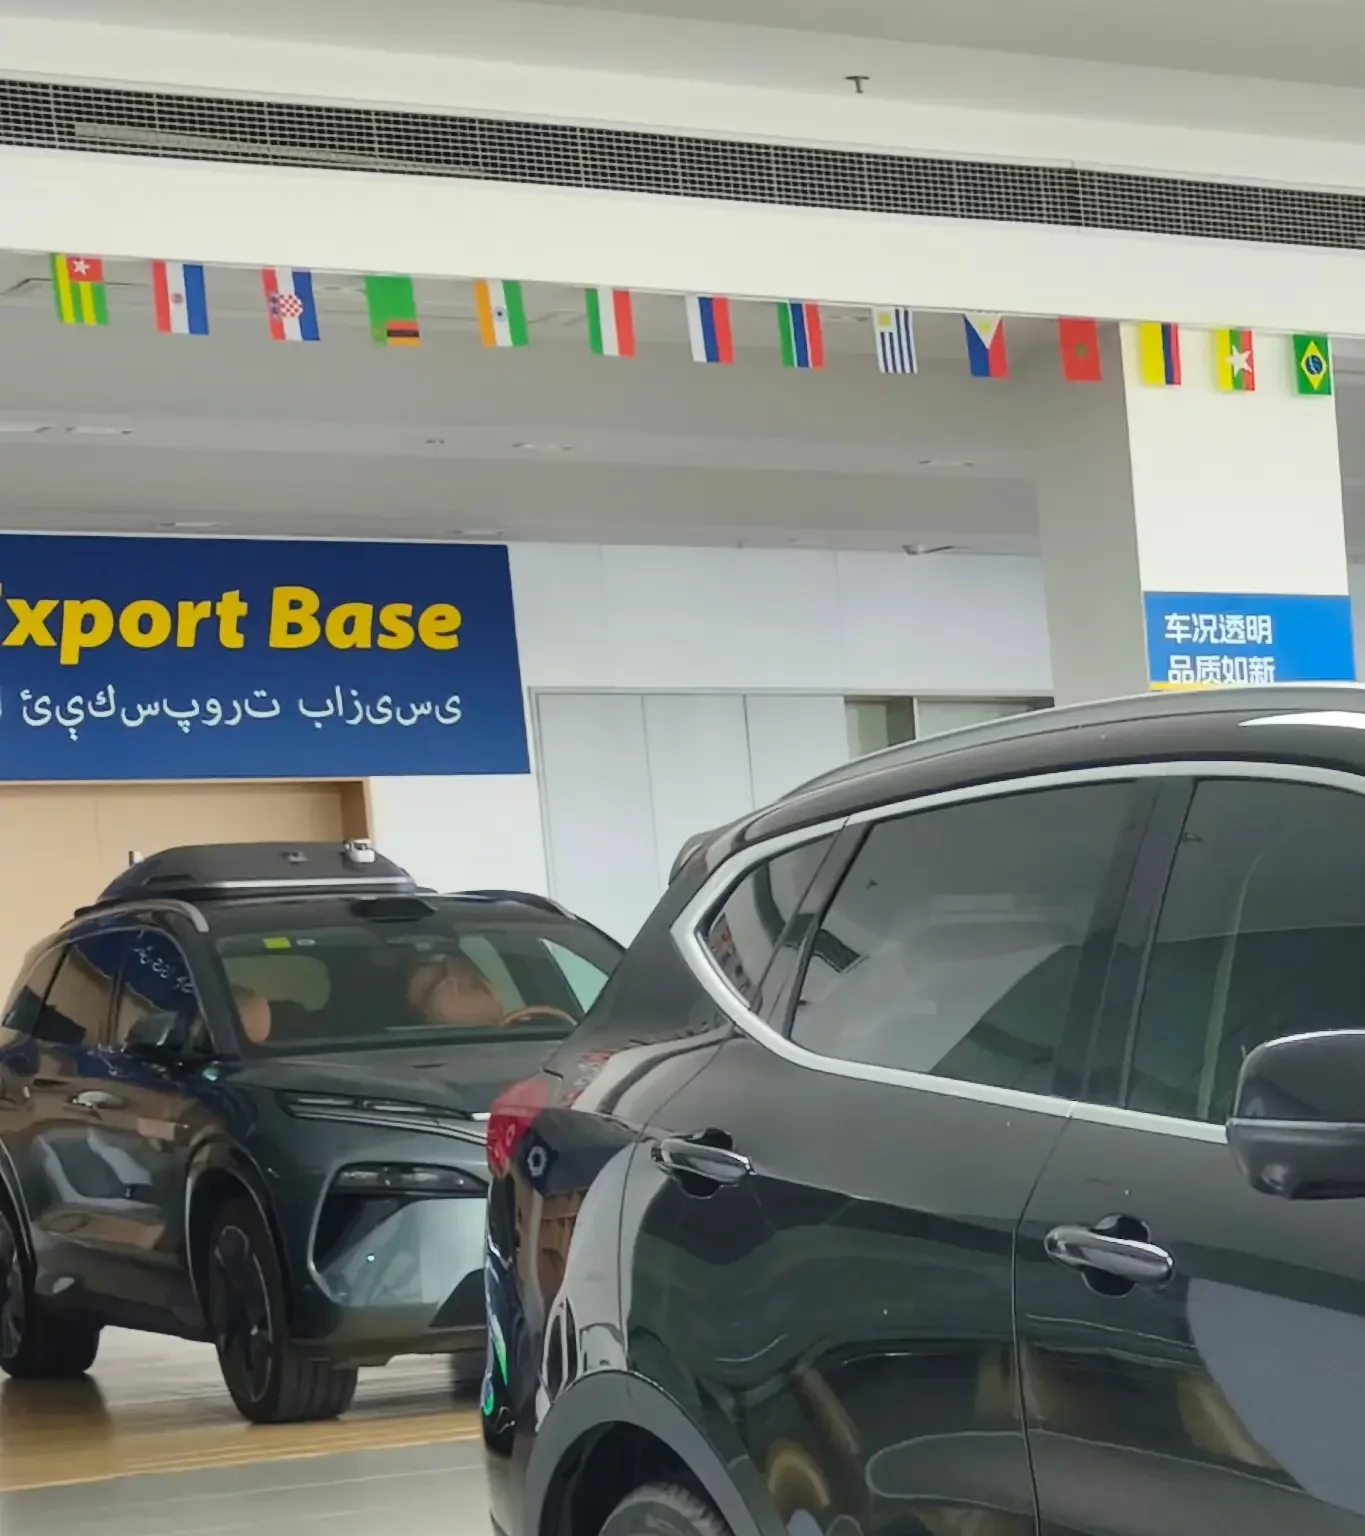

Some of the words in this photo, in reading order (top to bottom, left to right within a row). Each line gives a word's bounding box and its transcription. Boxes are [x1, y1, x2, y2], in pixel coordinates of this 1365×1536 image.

[0, 583, 248, 665] xport
[269, 586, 462, 650] Base
[1164, 612, 1273, 644] 车况透明
[1167, 654, 1276, 684] 品质如新
